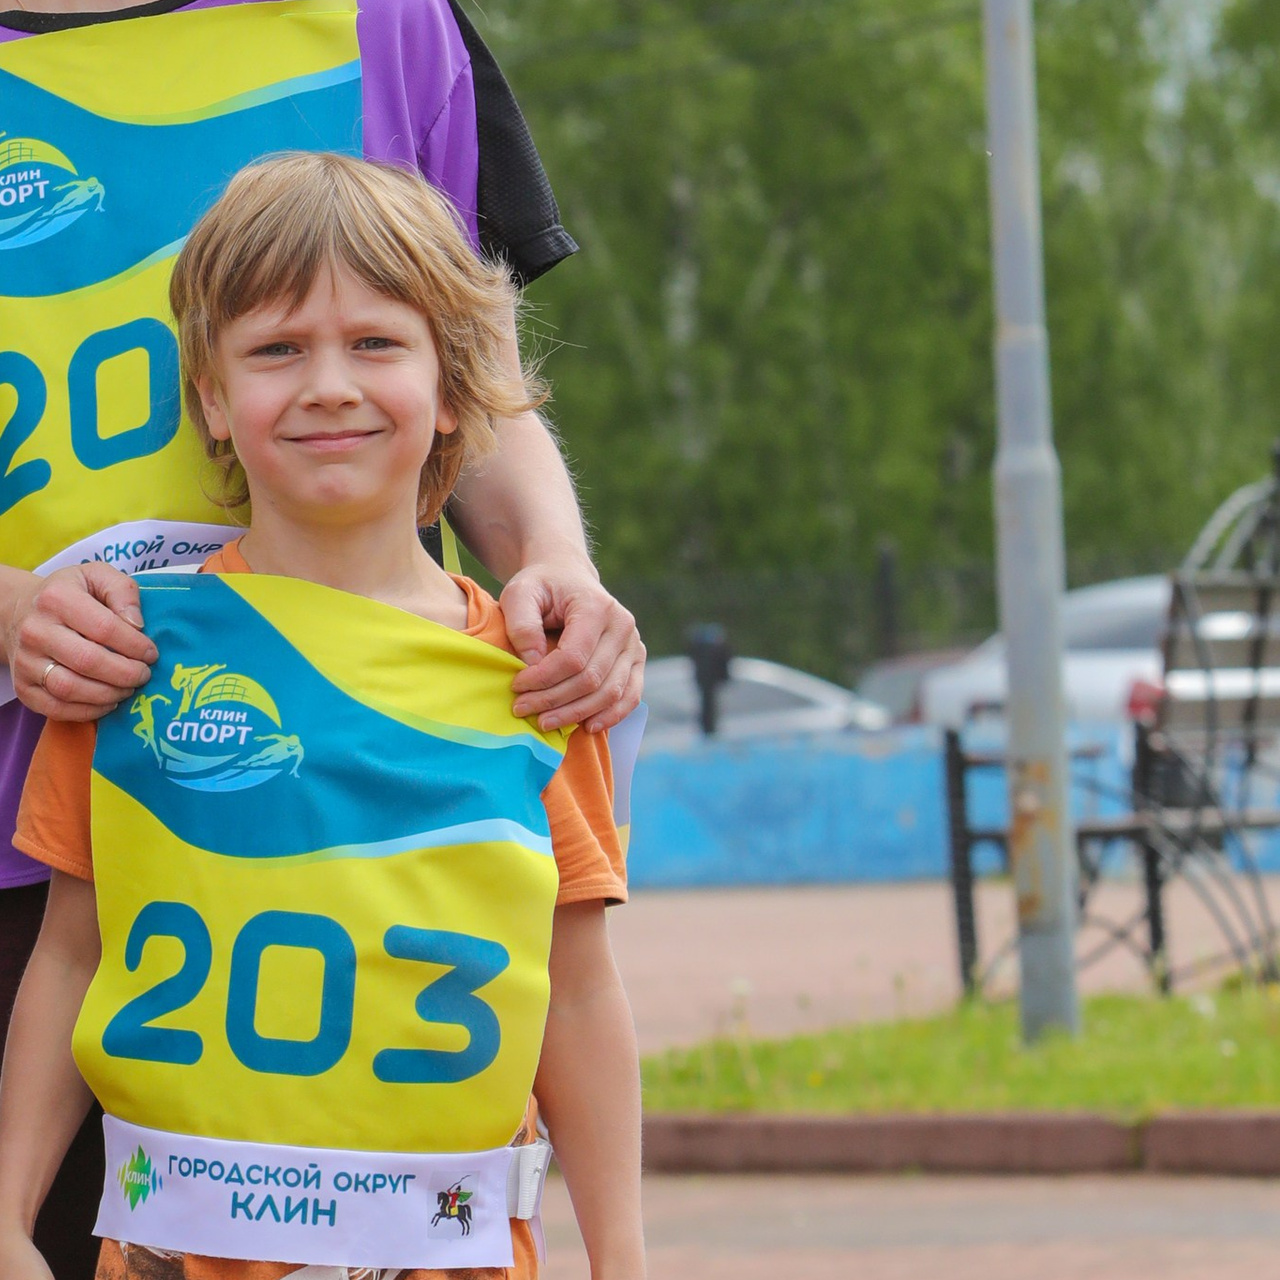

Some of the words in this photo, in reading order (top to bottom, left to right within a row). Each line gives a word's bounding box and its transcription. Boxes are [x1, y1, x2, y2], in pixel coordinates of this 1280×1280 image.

[166, 721, 253, 745] СПОРТ
[200, 708, 247, 723] КЛИН
[102, 901, 510, 1084] 203
[169, 1155, 320, 1190] ГОРОДСКОЙ
[333, 1172, 416, 1194] ОКРУГ
[231, 1191, 337, 1227] КЛИН
